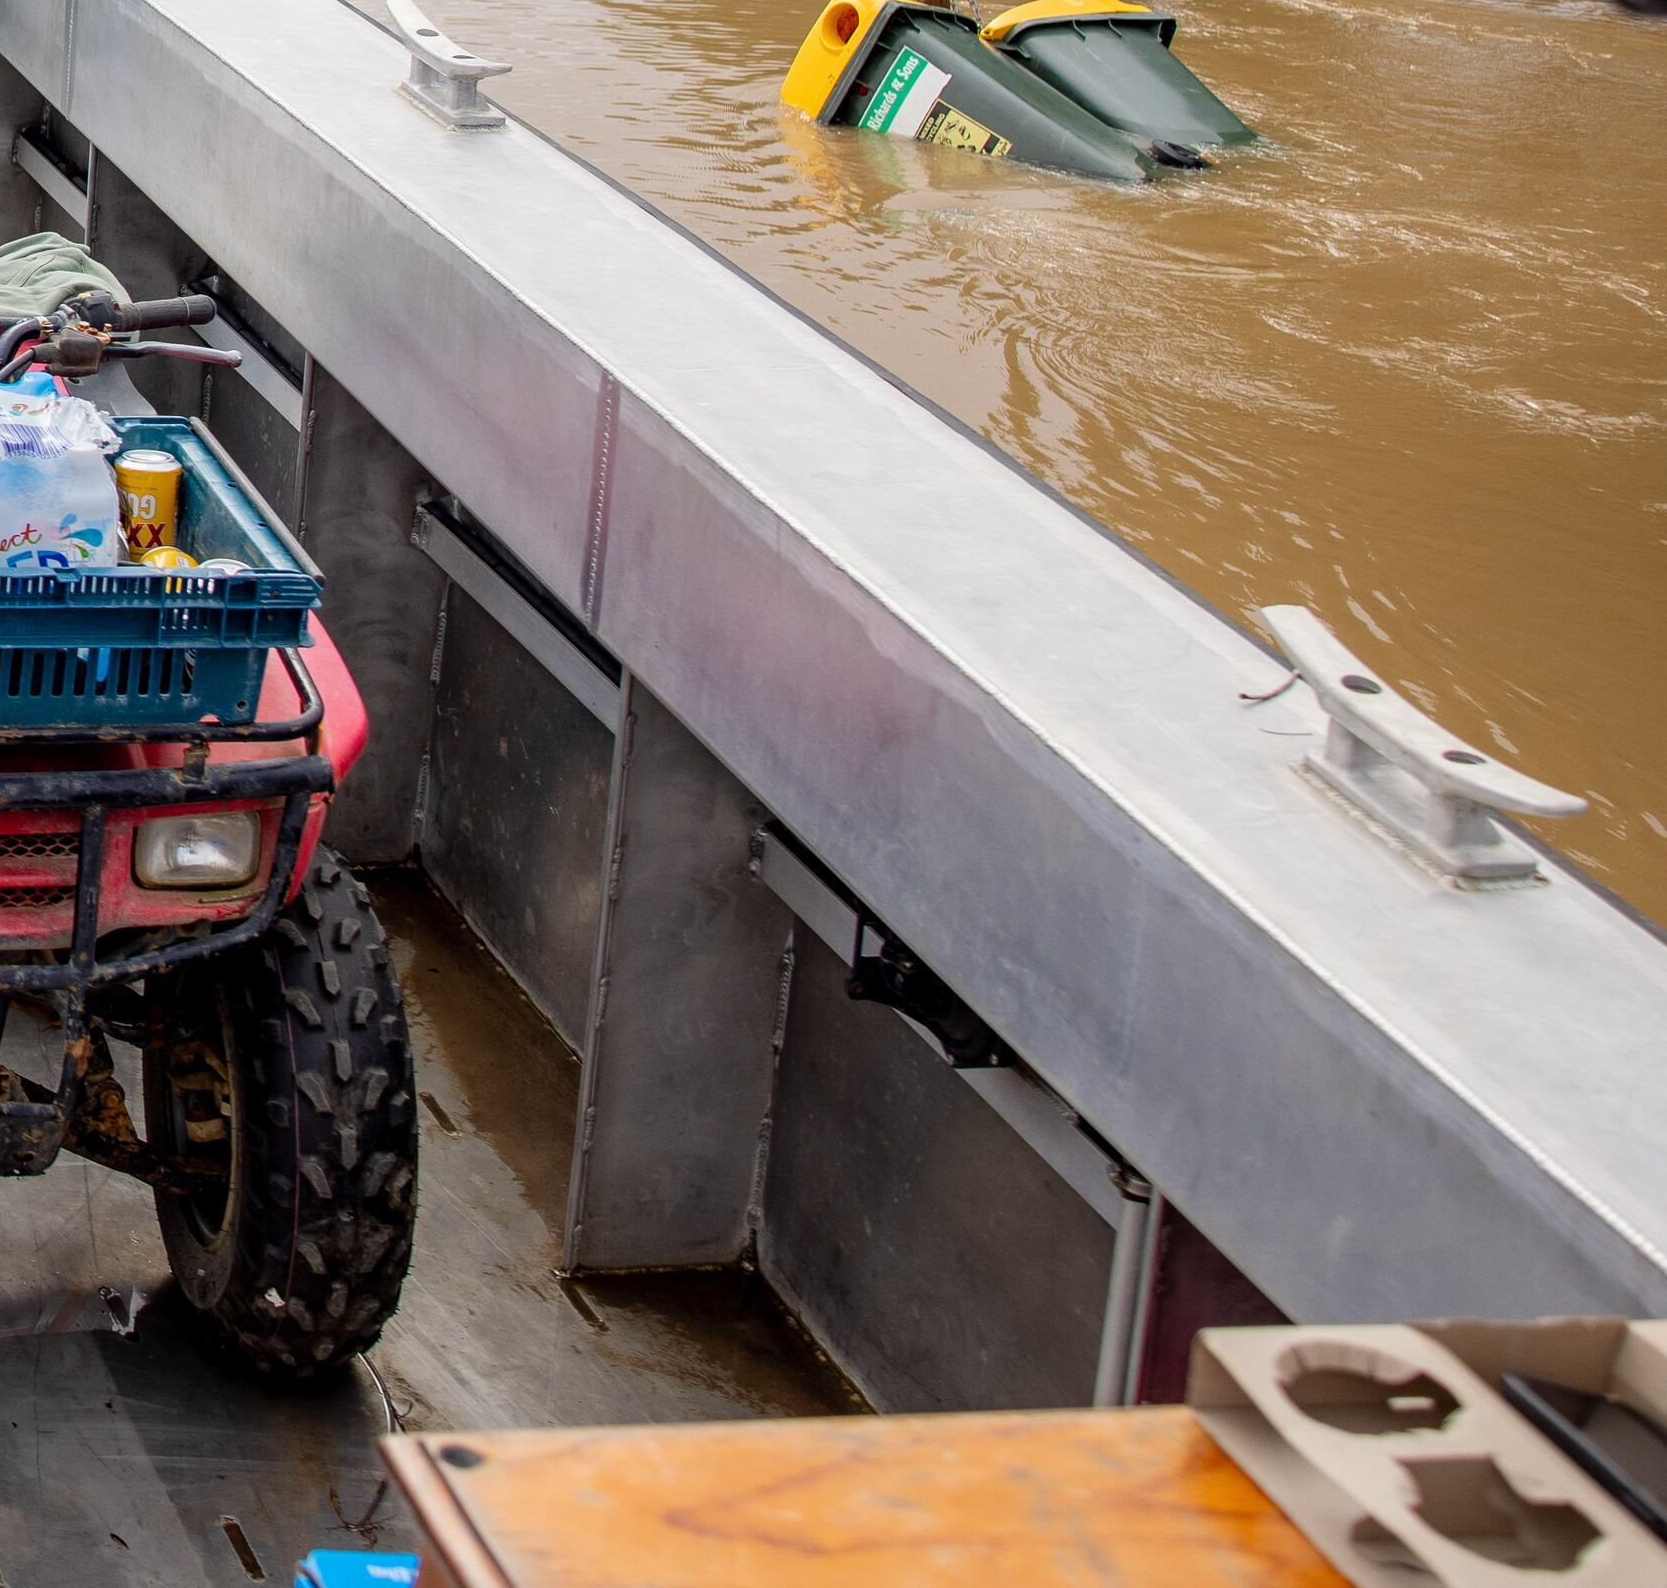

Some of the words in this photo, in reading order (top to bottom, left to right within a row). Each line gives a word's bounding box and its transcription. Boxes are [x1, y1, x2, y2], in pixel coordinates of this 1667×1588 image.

[867, 89, 897, 132] Richards
[896, 55, 920, 80] Sons
[919, 116, 935, 140] MIXED
[925, 113, 946, 142] CYCLING
